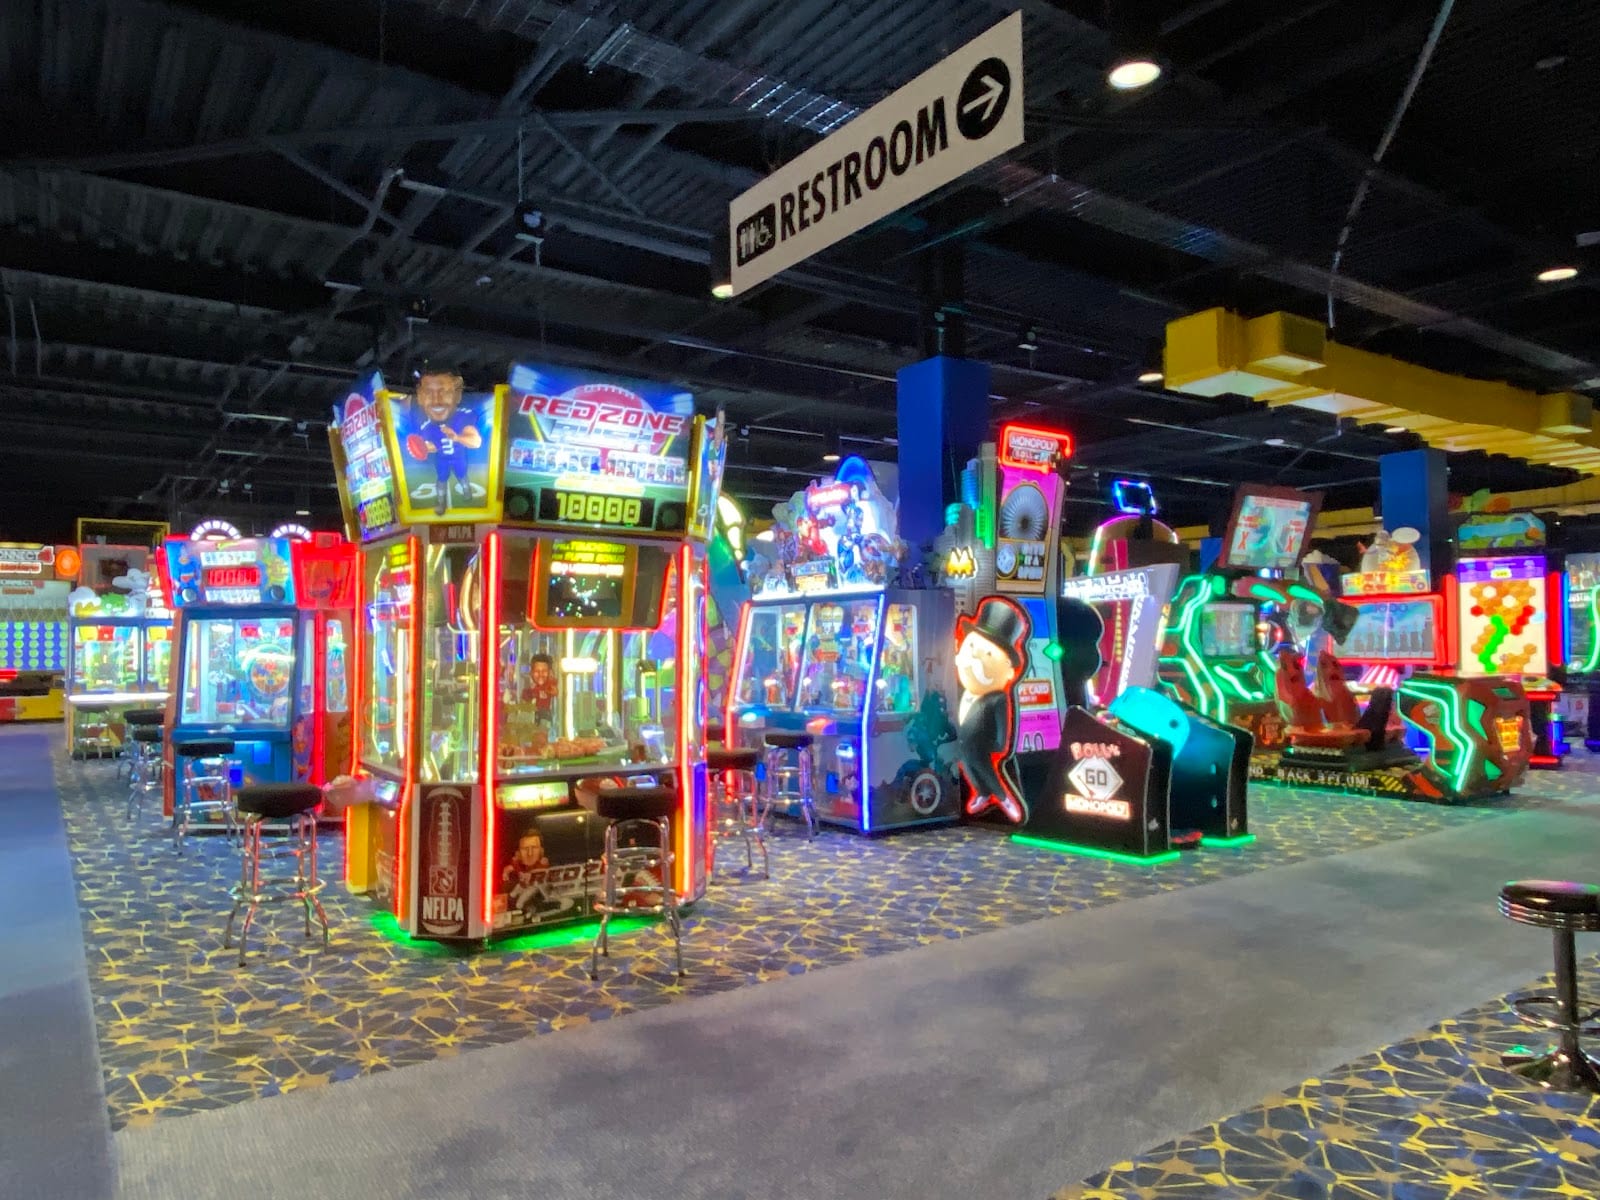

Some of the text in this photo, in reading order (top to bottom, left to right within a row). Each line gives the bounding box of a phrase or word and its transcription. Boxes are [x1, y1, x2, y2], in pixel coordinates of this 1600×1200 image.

[780, 96, 948, 242] RESTROOM
[556, 491, 641, 524] 10000
[1085, 768, 1107, 786] GO
[1067, 795, 1127, 817] MONOPOLY
[422, 896, 465, 921] NFLPA
